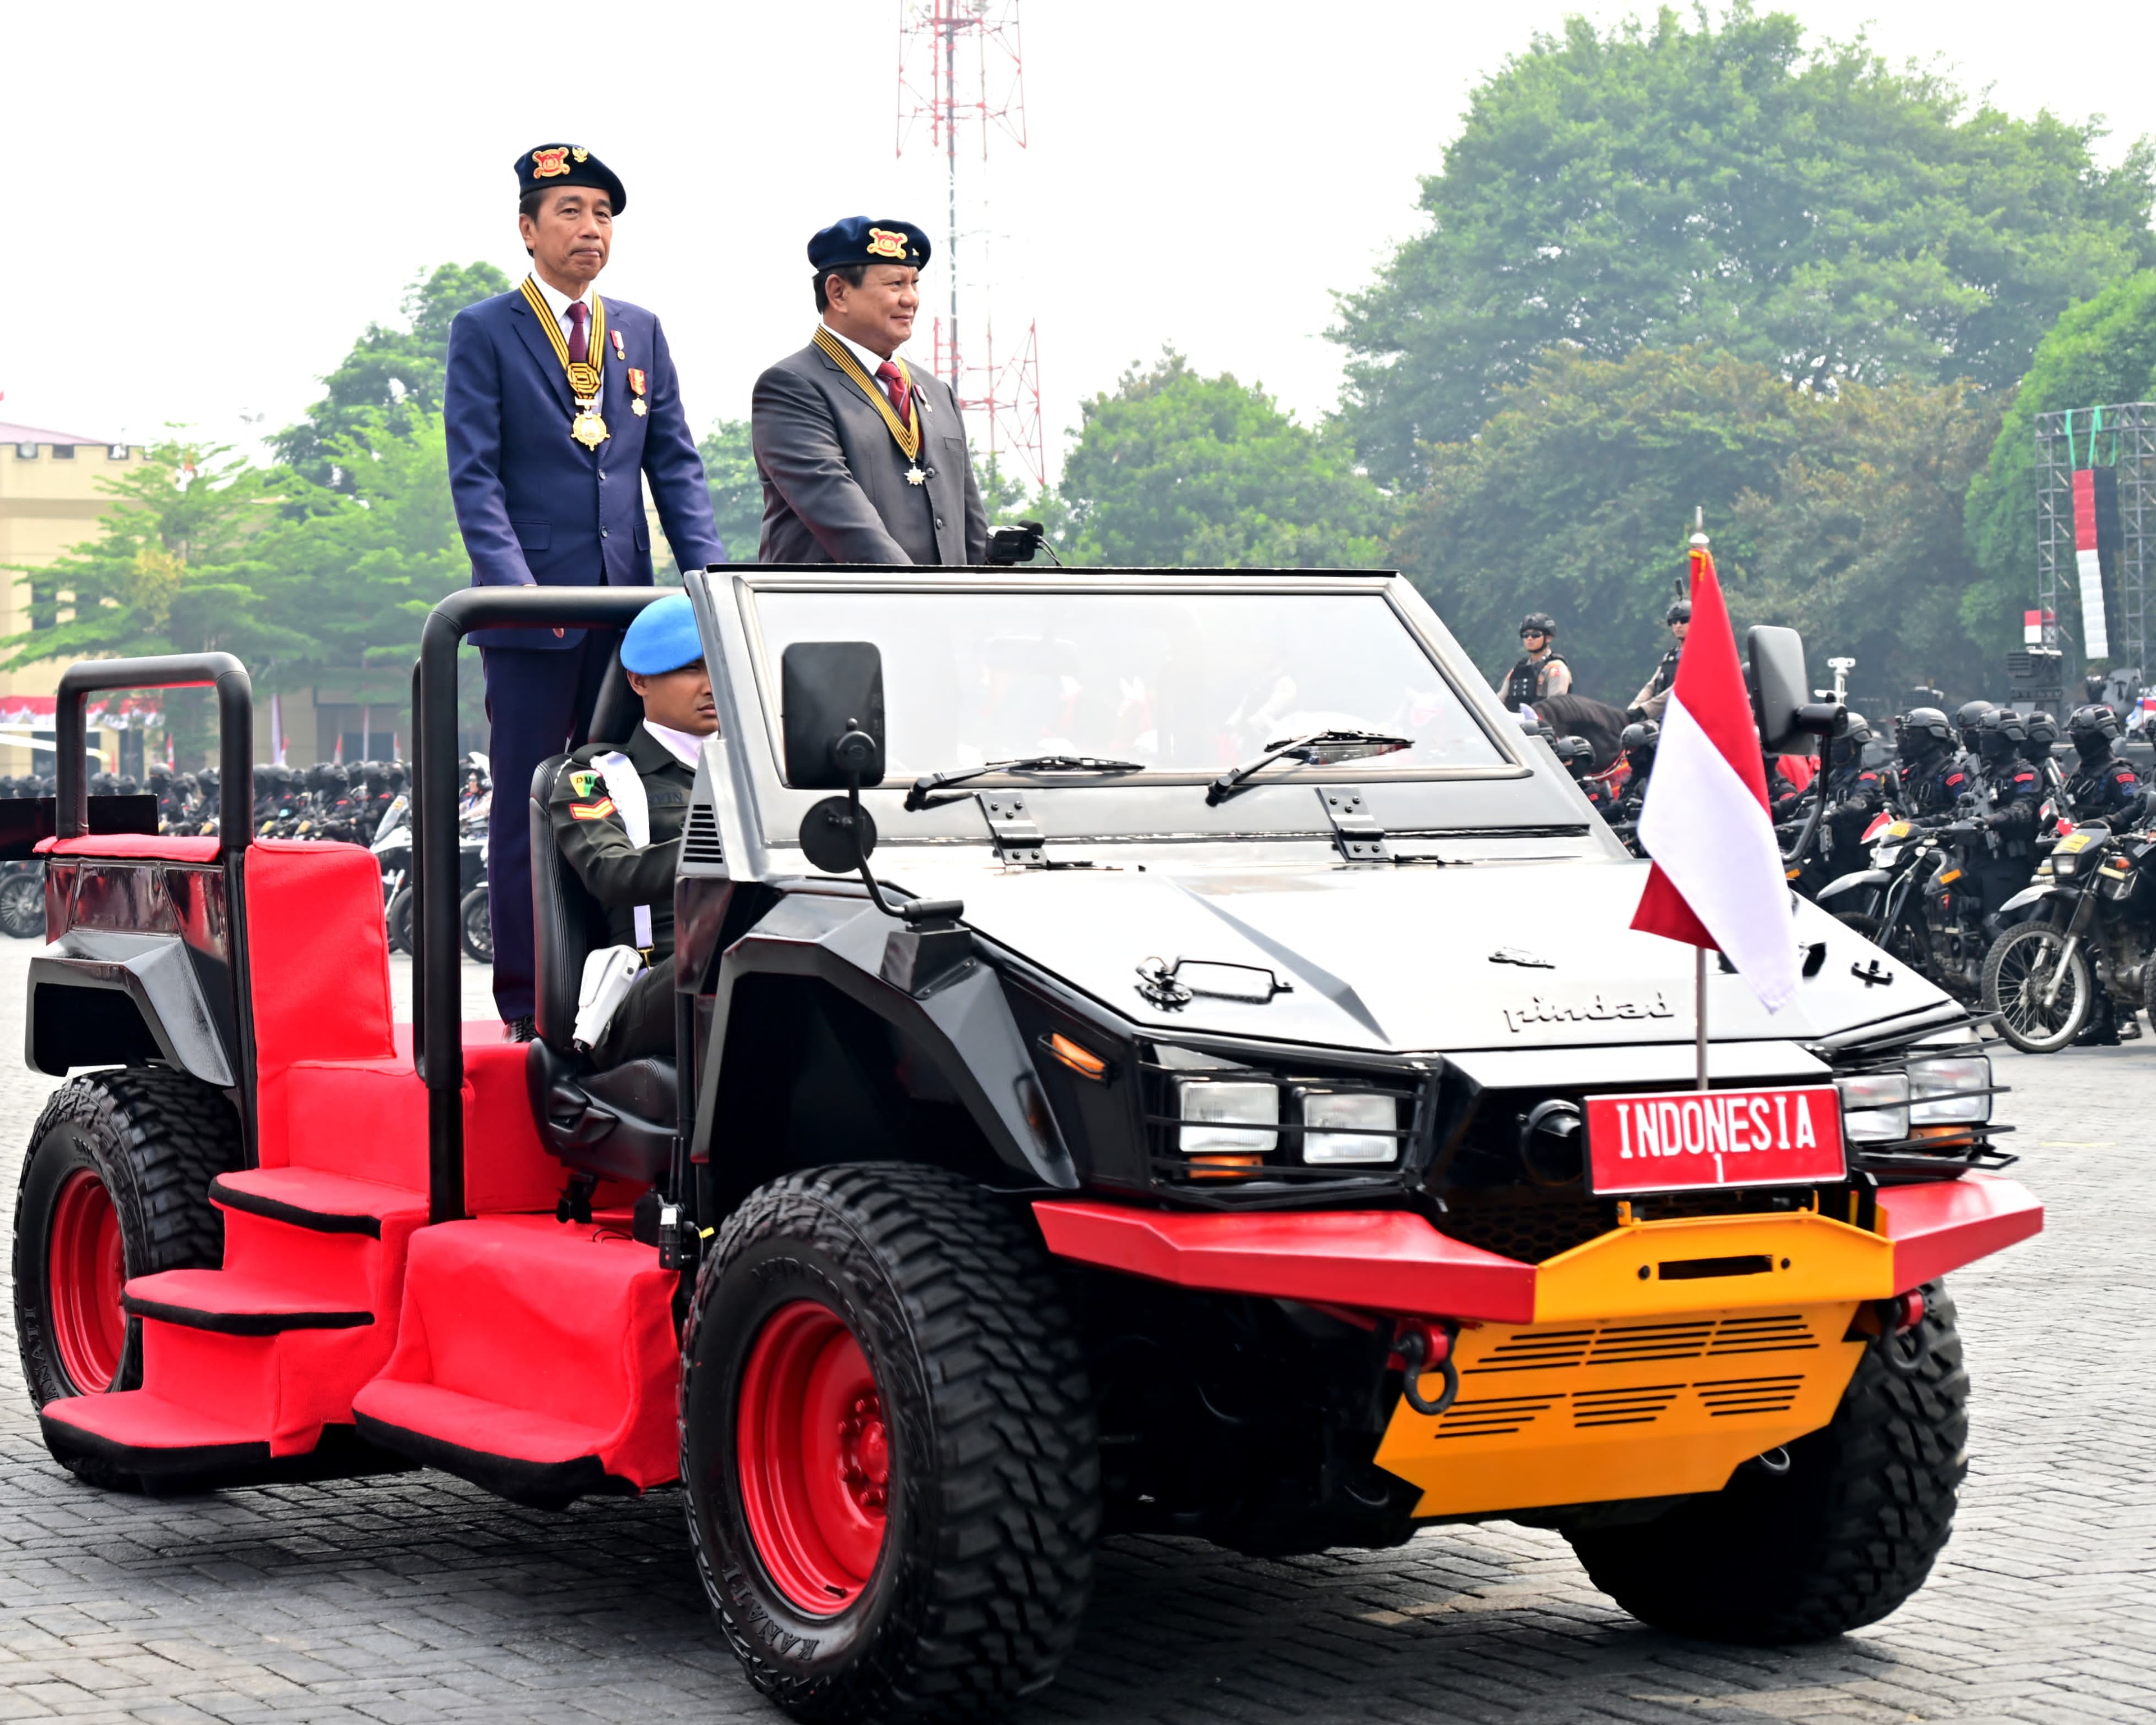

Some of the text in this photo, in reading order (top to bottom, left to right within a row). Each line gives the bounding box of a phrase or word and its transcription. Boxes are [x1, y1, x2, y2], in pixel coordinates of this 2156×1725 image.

[1616, 1096, 1816, 1158] INDONESIA
[1714, 1153, 1724, 1183] 1
[721, 1561, 820, 1660] KANATI
